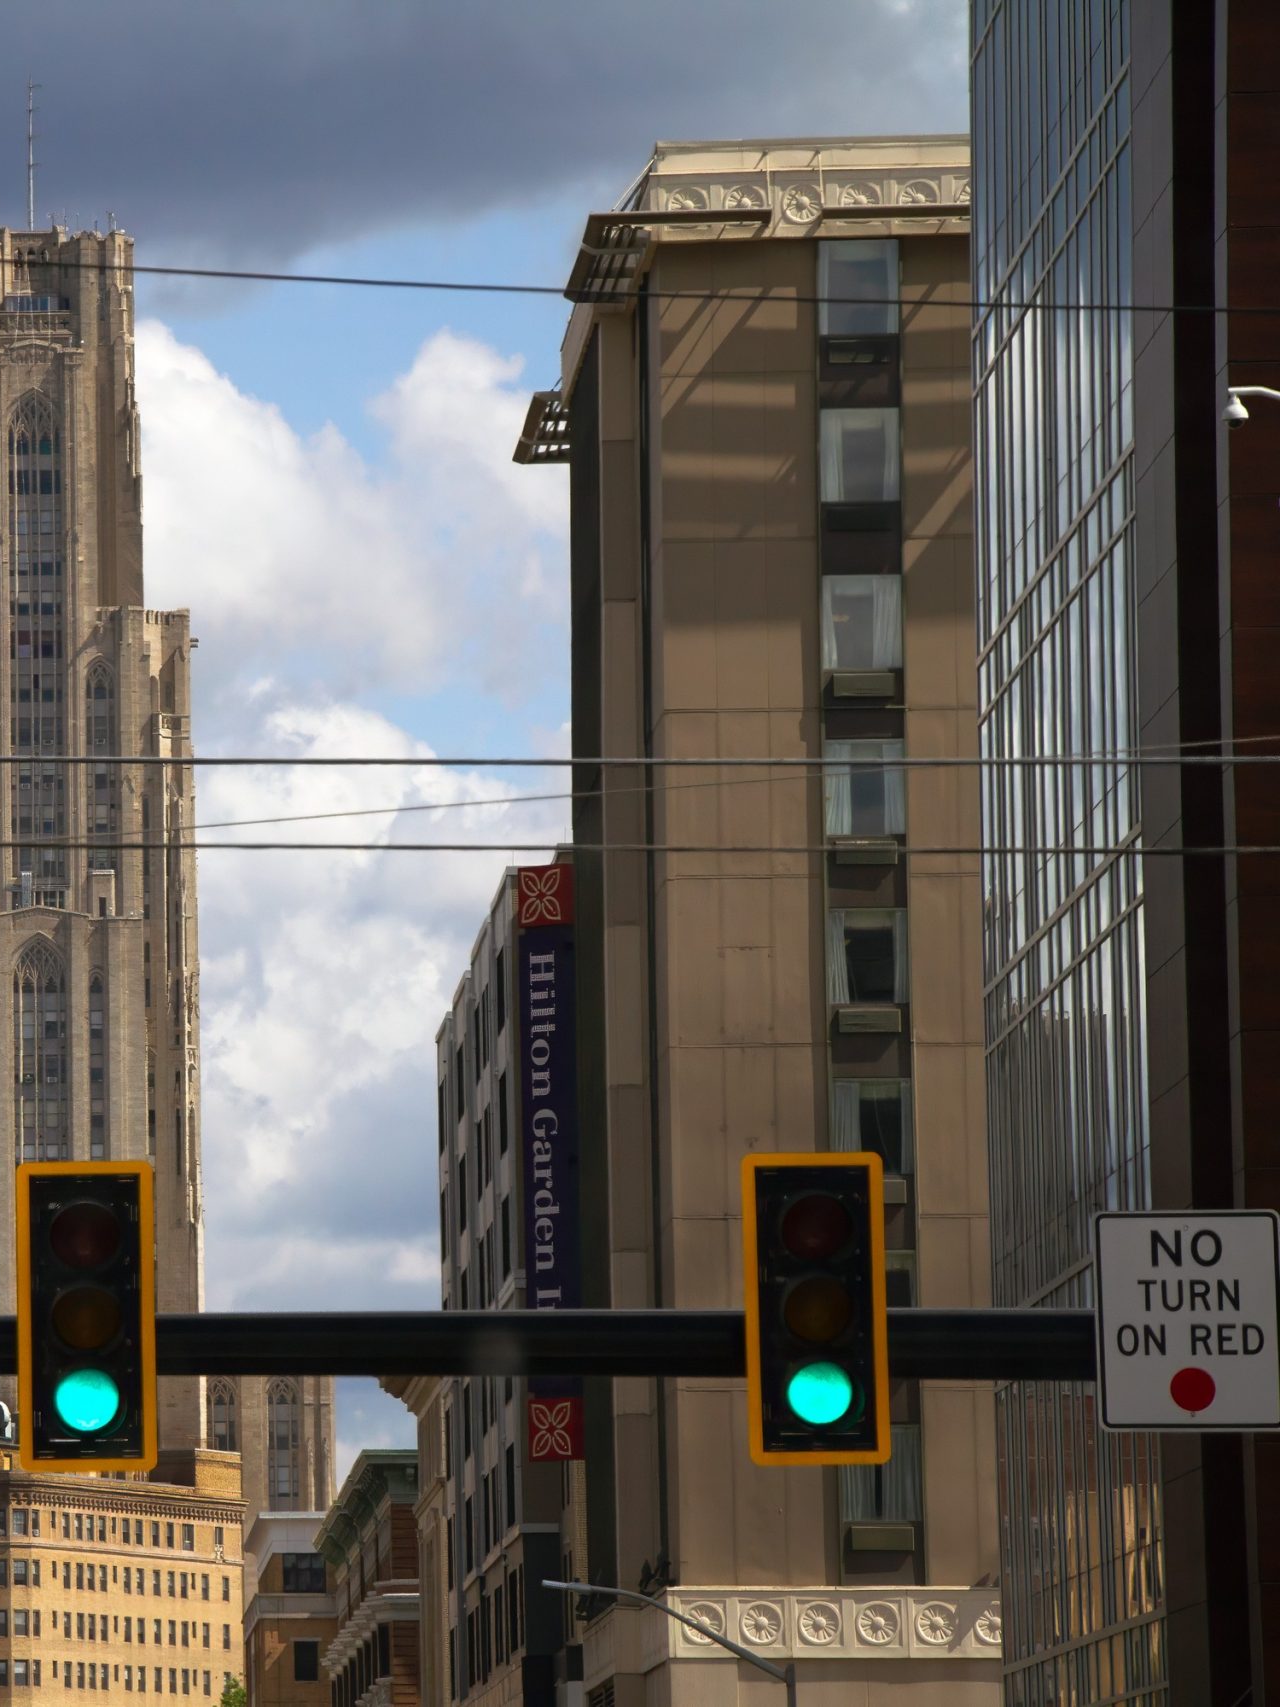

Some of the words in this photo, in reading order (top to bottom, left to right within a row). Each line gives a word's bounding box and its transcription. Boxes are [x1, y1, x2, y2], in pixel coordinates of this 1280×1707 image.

[530, 951, 556, 1099] Hilton
[532, 1108, 560, 1273] Garden
[1150, 1229, 1222, 1267] NO
[1137, 1279, 1240, 1312] TURN
[1117, 1324, 1166, 1356] ON
[1190, 1323, 1265, 1356] RED
